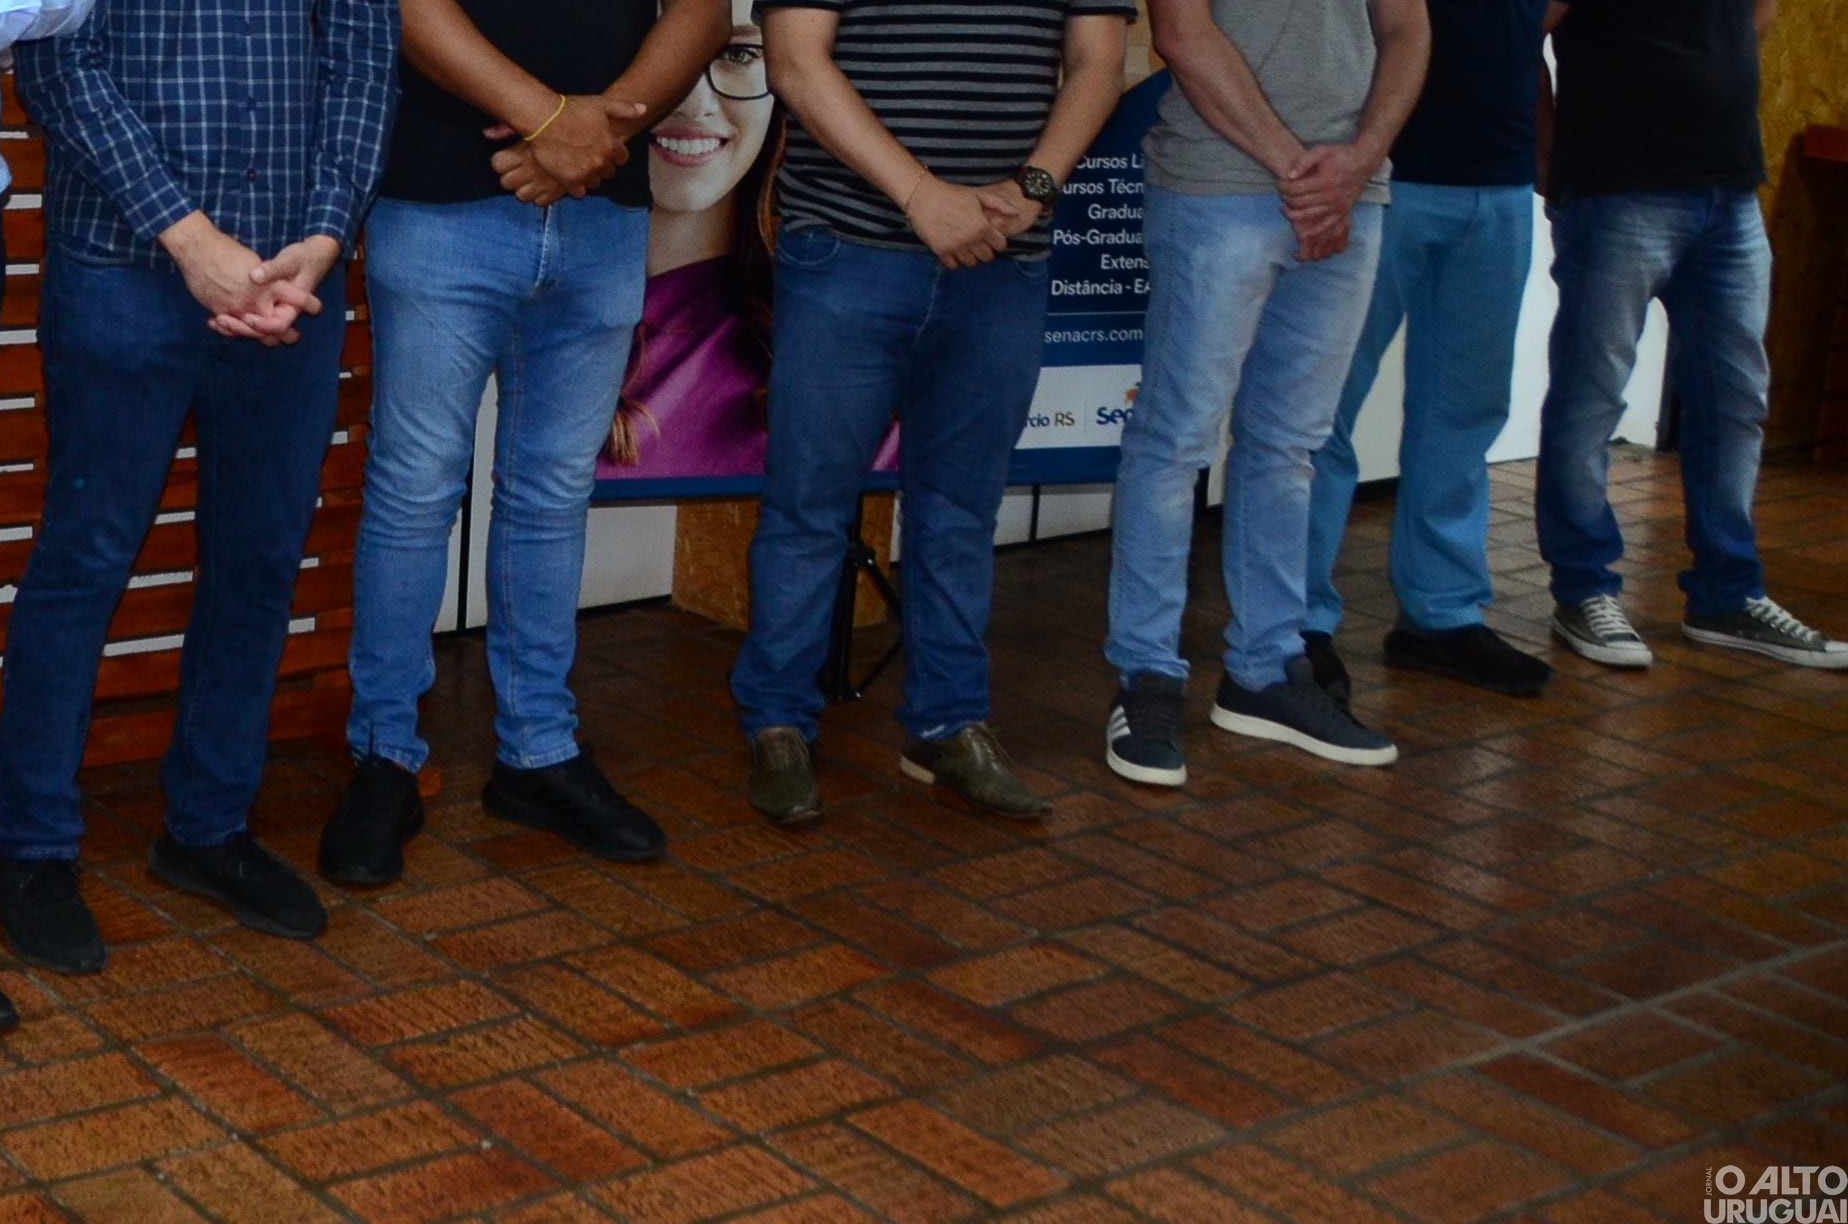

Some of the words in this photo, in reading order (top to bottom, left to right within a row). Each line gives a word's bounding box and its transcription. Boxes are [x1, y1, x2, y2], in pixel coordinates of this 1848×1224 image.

[1131, 153, 1144, 169] Li
[1063, 182, 1104, 194] ursos
[1108, 178, 1145, 194] Técn
[1087, 204, 1144, 220] Gradua
[1053, 229, 1145, 246] Pós-Gradua
[1100, 254, 1150, 270] Extens
[1051, 279, 1123, 296] Distância
[1133, 278, 1151, 294] EA
[1042, 327, 1144, 344] senacrs.com
[1026, 412, 1051, 427] rcio
[1054, 410, 1076, 427] RS
[1095, 405, 1135, 426] Sen
